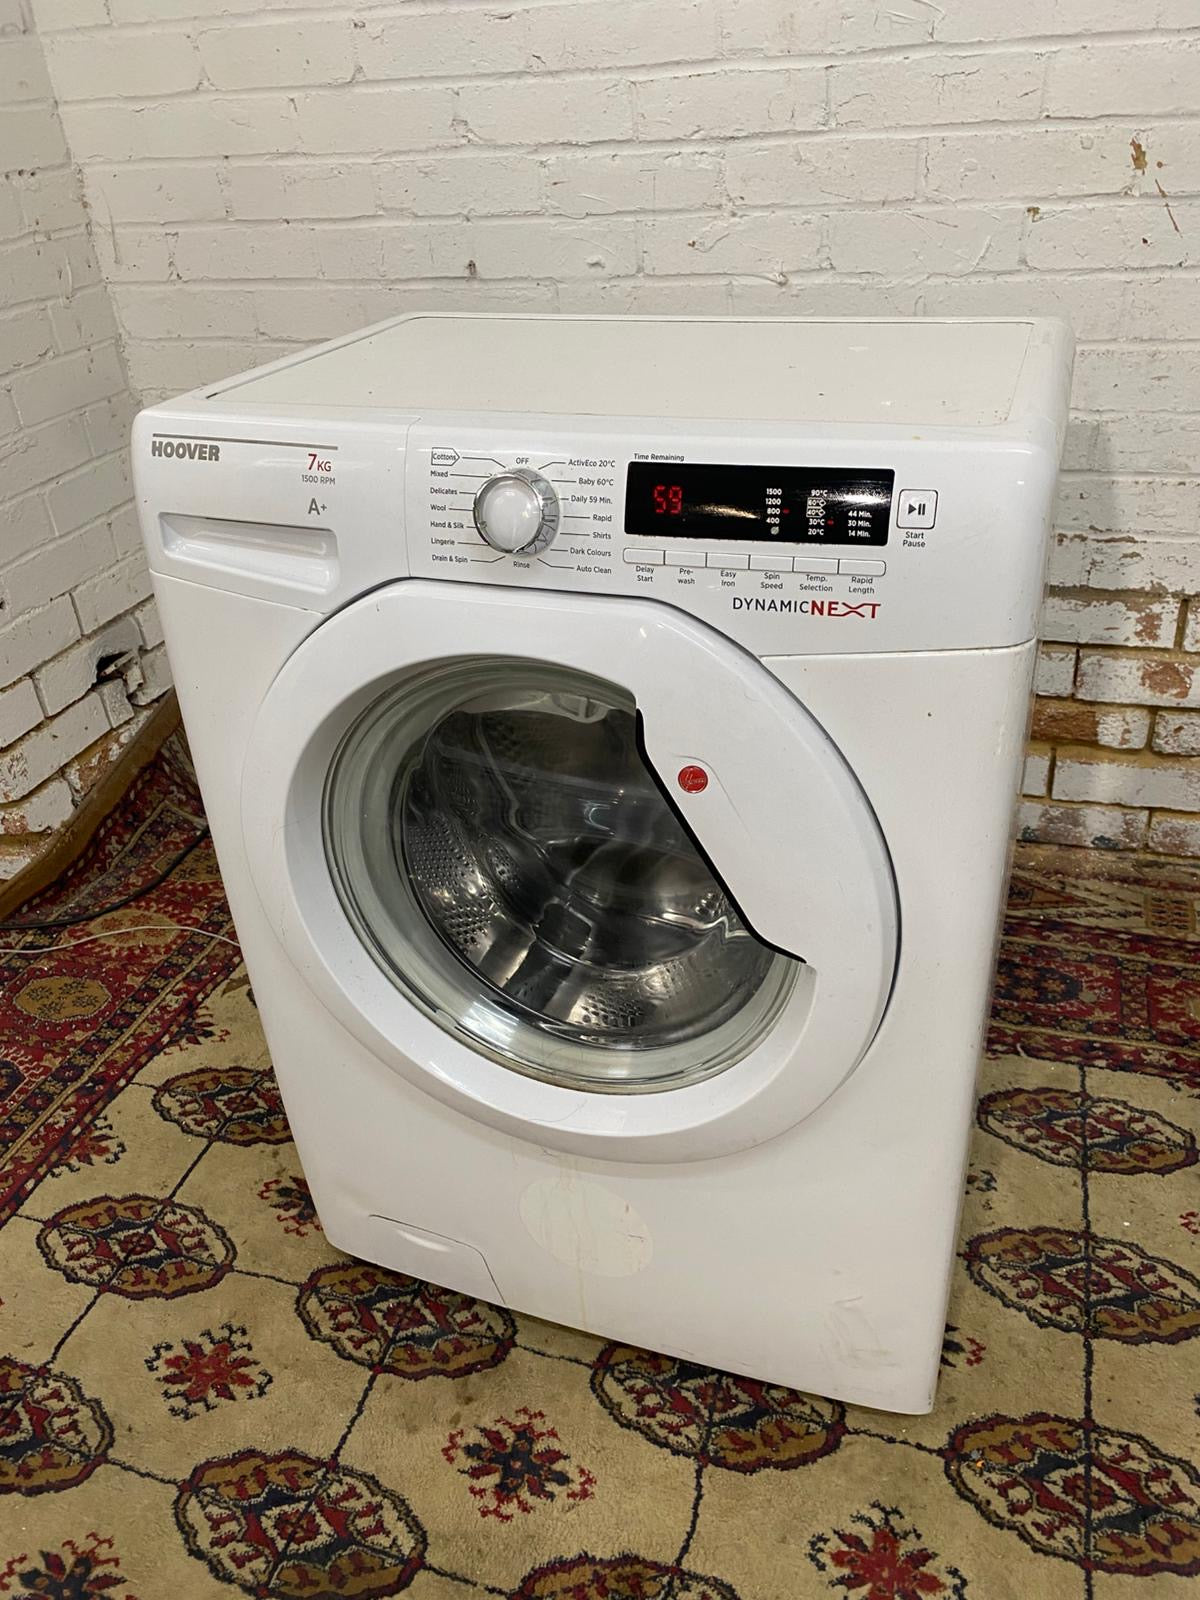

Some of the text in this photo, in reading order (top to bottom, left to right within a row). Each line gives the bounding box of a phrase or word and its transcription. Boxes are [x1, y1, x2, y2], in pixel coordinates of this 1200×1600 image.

[152, 440, 220, 462] HOOVER
[432, 453, 457, 462] Cottons
[515, 457, 529, 465] OFF
[651, 453, 685, 462] Remaining
[568, 459, 616, 468] ActivEco 20°C
[430, 470, 449, 478] Mixed
[301, 474, 336, 485] 1500 RPM
[578, 478, 614, 487] Baby 60°C
[430, 487, 458, 495] Delicates
[766, 488, 782, 496] 1500
[571, 495, 613, 505] Daily 59 Min.
[654, 484, 683, 514] 59
[765, 498, 781, 506] 1200
[307, 498, 328, 516] A+
[430, 504, 447, 512] Wool
[593, 514, 612, 523] Rapid
[848, 510, 858, 518] 44
[430, 521, 465, 530] Hand & Silk
[766, 517, 780, 525] 400
[593, 531, 612, 540] Shirts
[905, 531, 925, 540] Start
[430, 538, 455, 546] Lingerie
[902, 540, 926, 548] Pause
[570, 547, 612, 557] Dark Colours
[432, 554, 469, 565] Drain & Spin
[513, 561, 530, 569] Rinse
[576, 565, 612, 574] Auto Clean
[635, 566, 654, 574] Delay
[720, 570, 736, 579] Easy
[764, 572, 781, 581] Spin
[806, 574, 828, 584] Temp.
[851, 576, 873, 586] Rapid
[721, 579, 736, 587] Iron
[760, 582, 784, 591] Speed
[799, 583, 833, 592] Selection
[848, 586, 875, 595] Length
